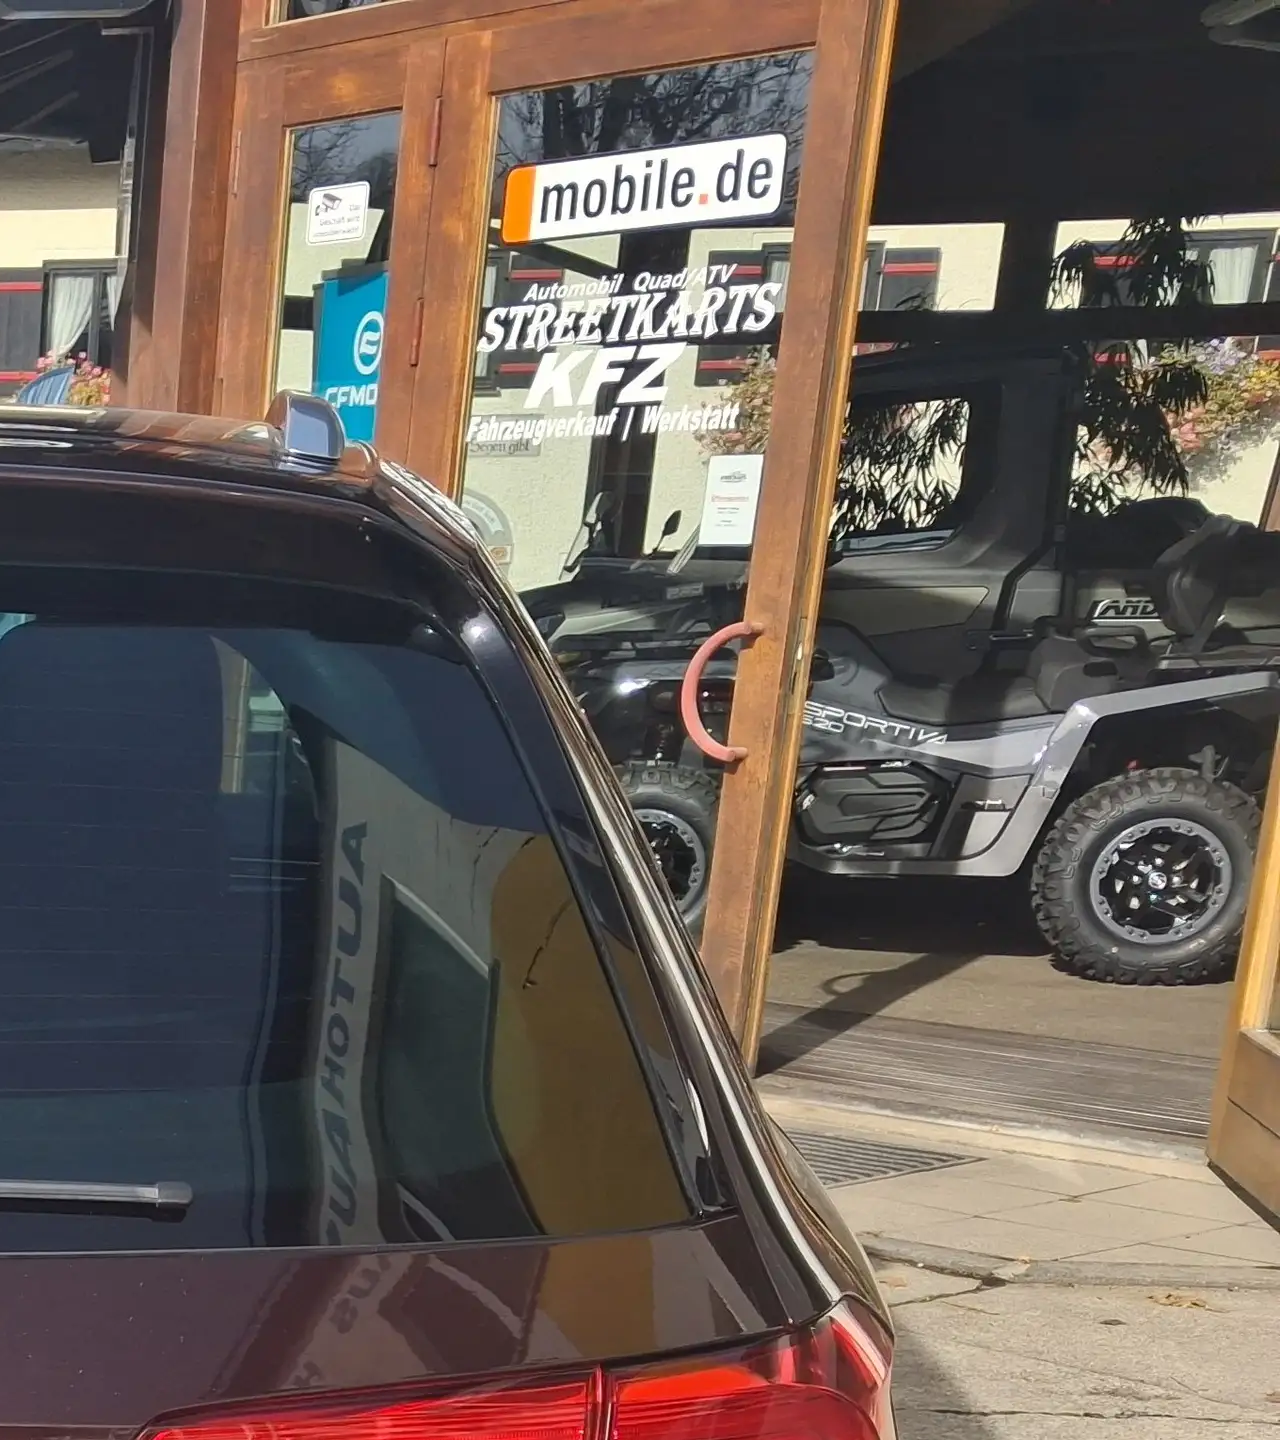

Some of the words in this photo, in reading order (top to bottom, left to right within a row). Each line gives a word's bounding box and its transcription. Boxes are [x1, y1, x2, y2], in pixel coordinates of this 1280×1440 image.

[540, 149, 773, 223] mobile.de
[524, 274, 623, 301] Automobil
[633, 263, 737, 291] Quad/ATV
[477, 282, 782, 352] STREETKARTS
[523, 342, 688, 409] KFZ
[466, 408, 619, 445] Fahrzeugverkauf
[641, 403, 740, 433] Werkstatt
[803, 700, 949, 745] SPORTIVA
